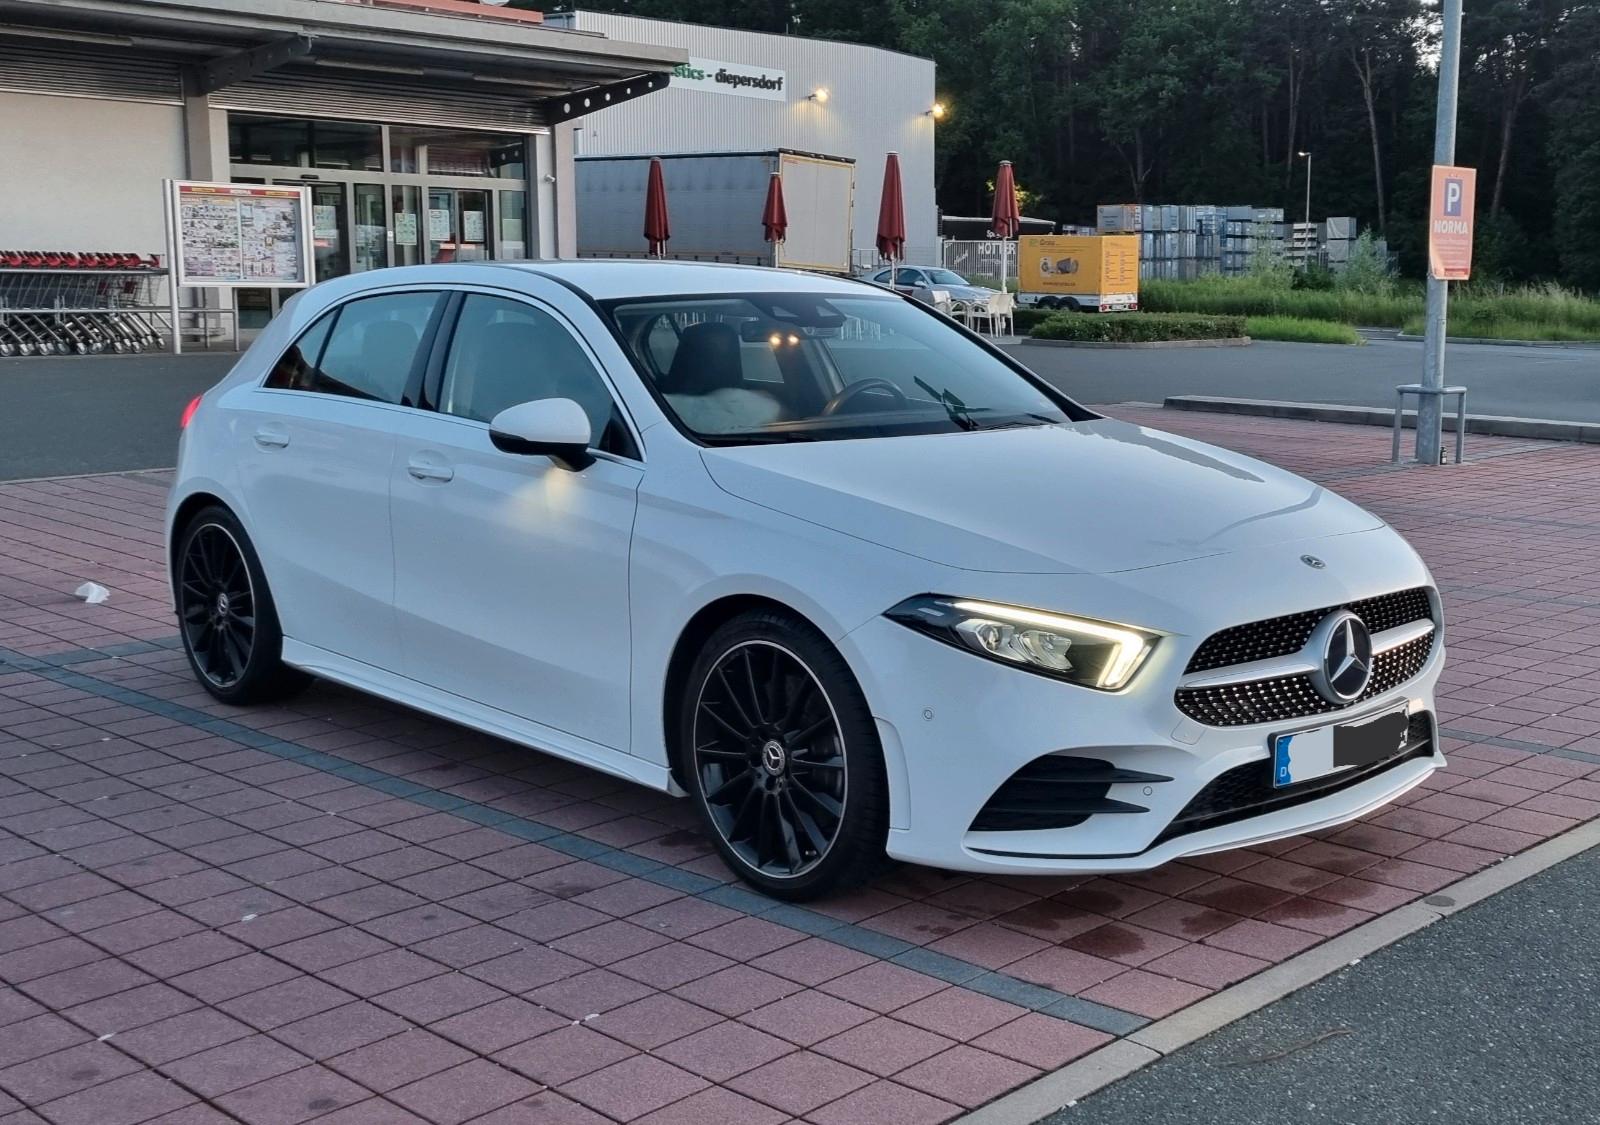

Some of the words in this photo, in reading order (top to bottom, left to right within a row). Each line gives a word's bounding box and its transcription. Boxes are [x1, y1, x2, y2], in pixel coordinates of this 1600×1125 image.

[673, 64, 705, 80] stics
[715, 68, 783, 91] diepersdorf
[1447, 182, 1460, 213] P
[1434, 220, 1468, 234] NORMA
